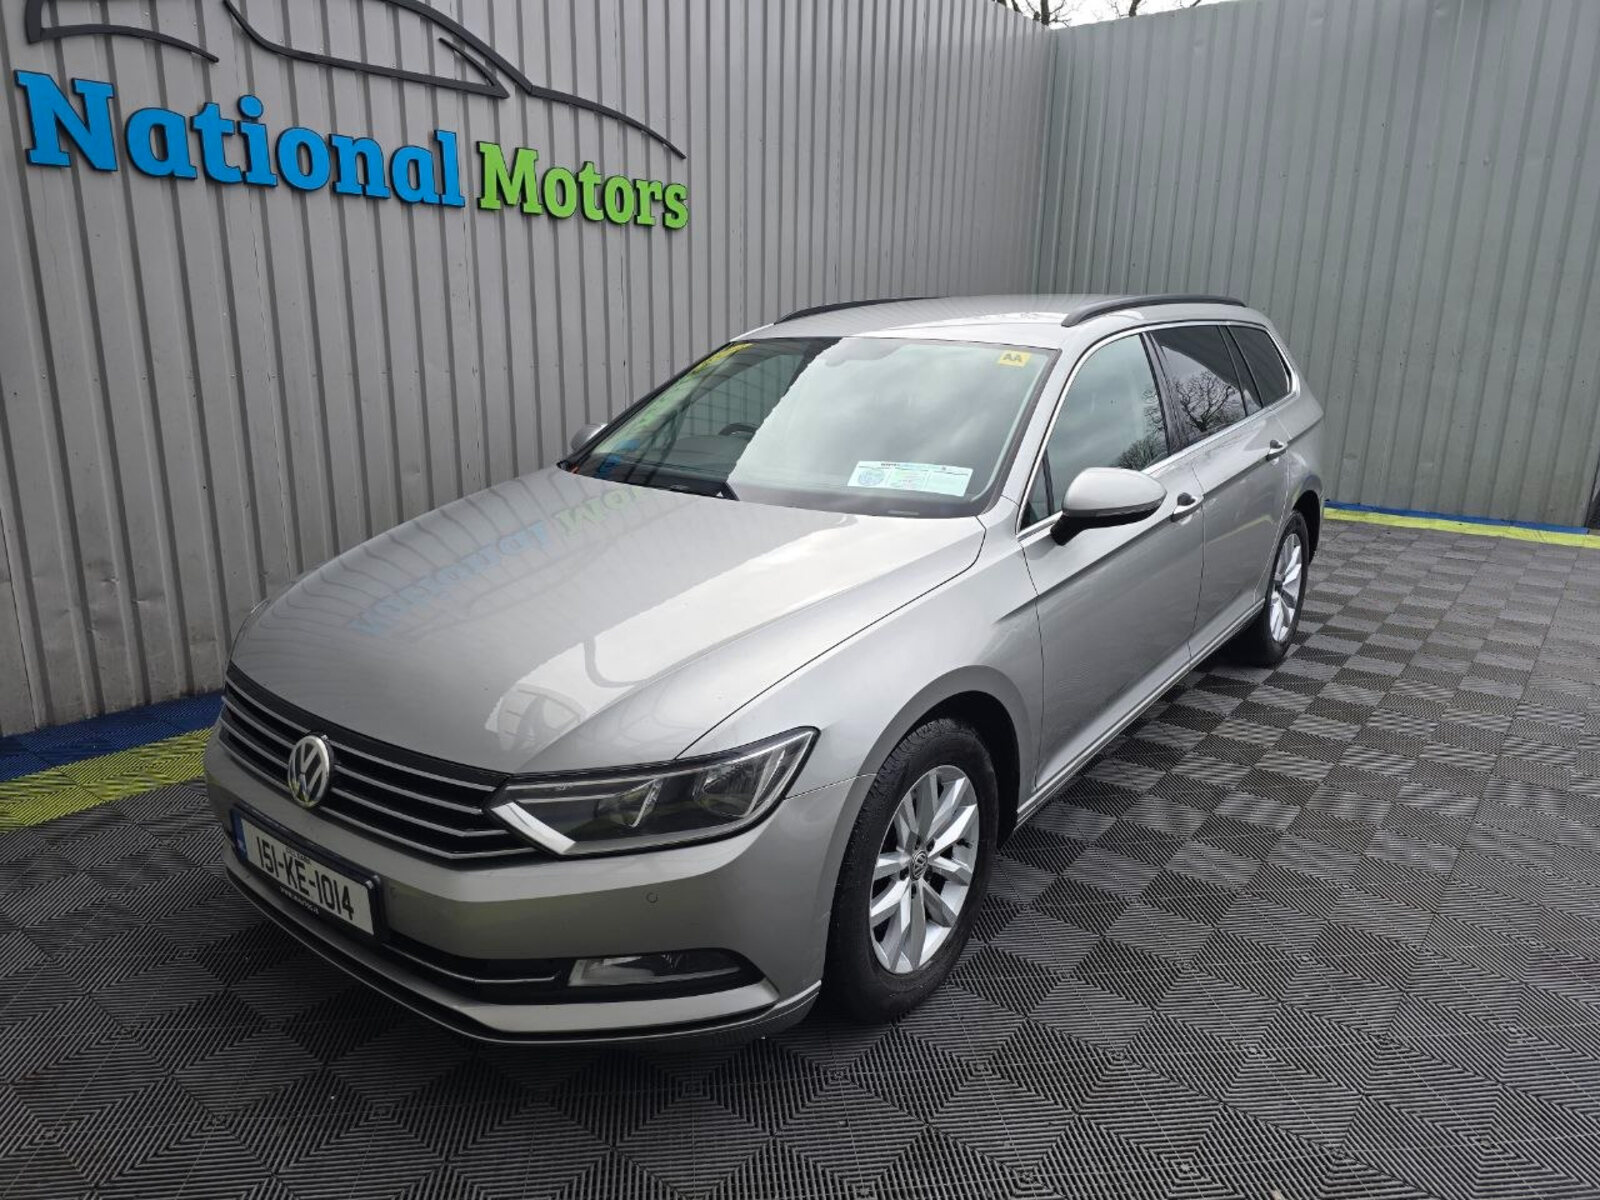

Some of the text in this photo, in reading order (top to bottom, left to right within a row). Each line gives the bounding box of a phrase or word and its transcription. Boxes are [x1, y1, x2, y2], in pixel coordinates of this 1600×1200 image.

[14, 69, 690, 230] National Motors
[1002, 352, 1023, 363] AA
[256, 835, 355, 921] 151-KE-1014
